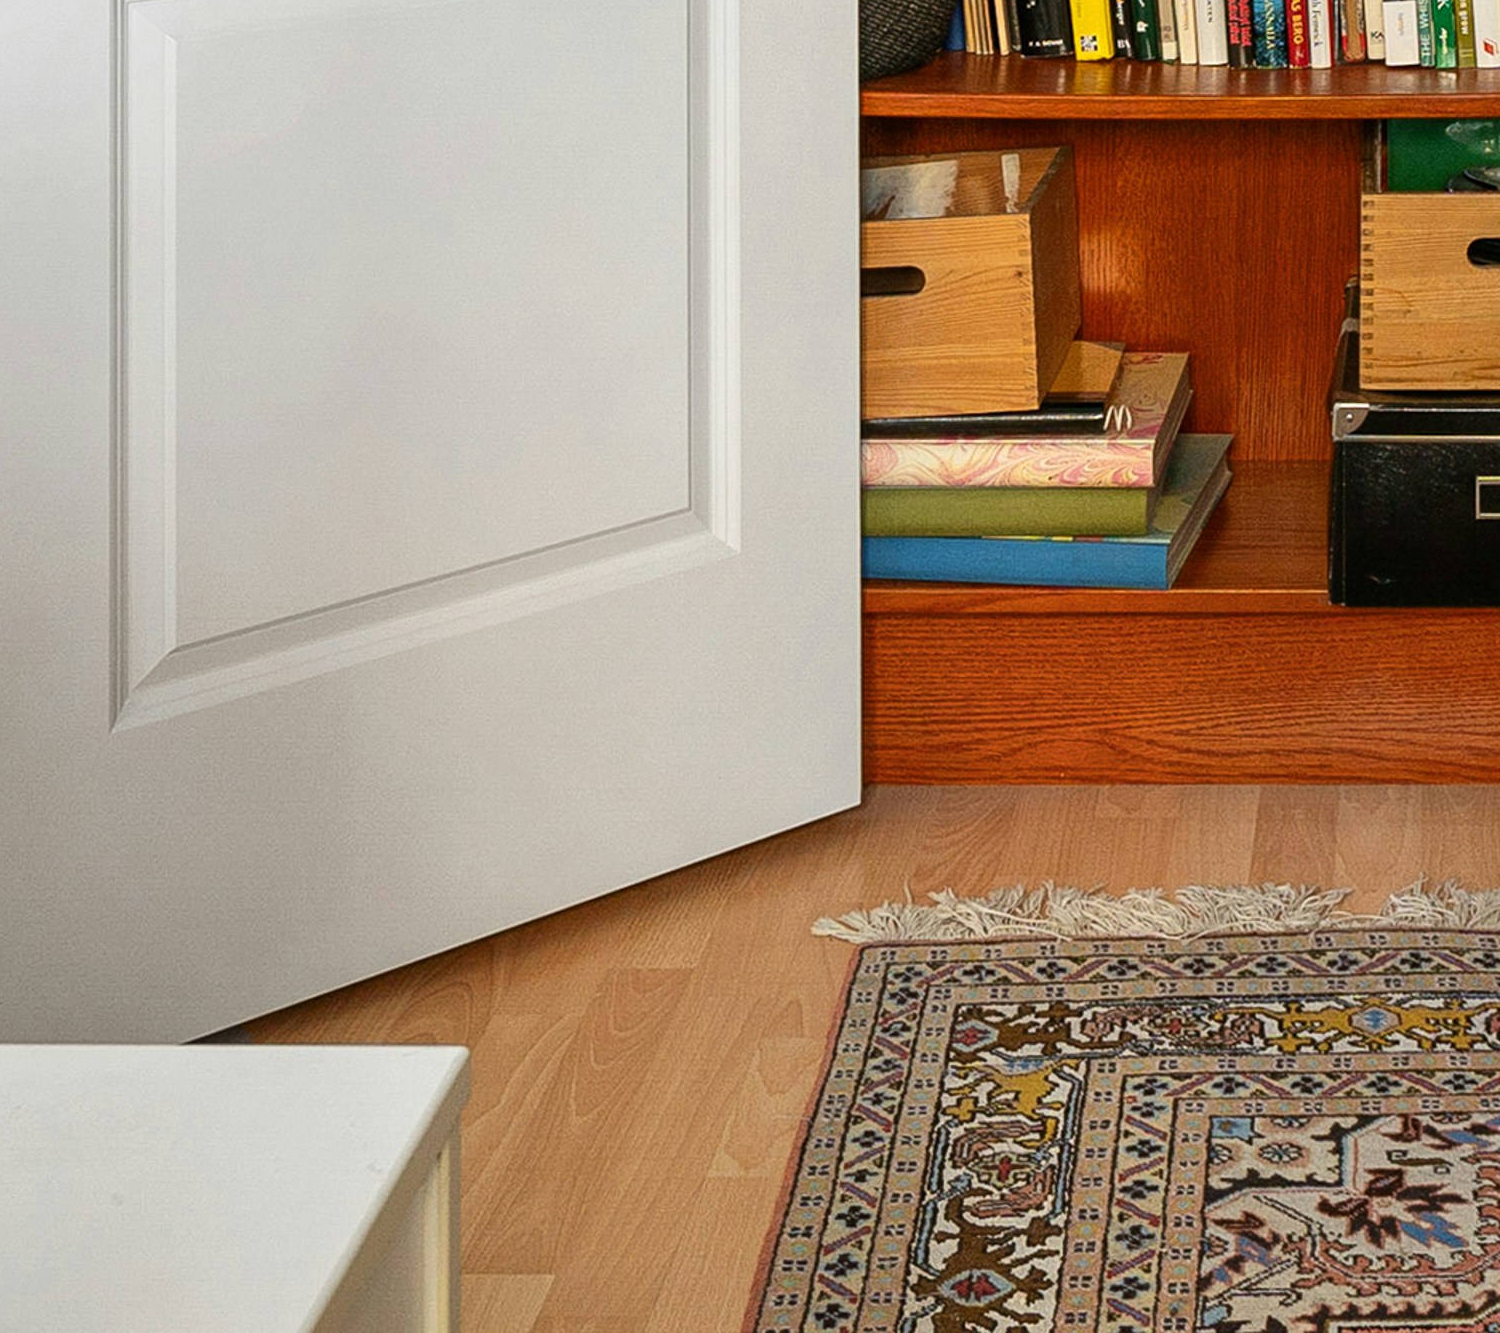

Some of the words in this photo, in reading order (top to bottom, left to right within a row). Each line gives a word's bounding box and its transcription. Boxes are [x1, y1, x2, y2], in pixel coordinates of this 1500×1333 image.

[1292, 15, 1304, 45] BERG
[1459, 10, 1470, 35] grow
[1420, 33, 1431, 57] THE
